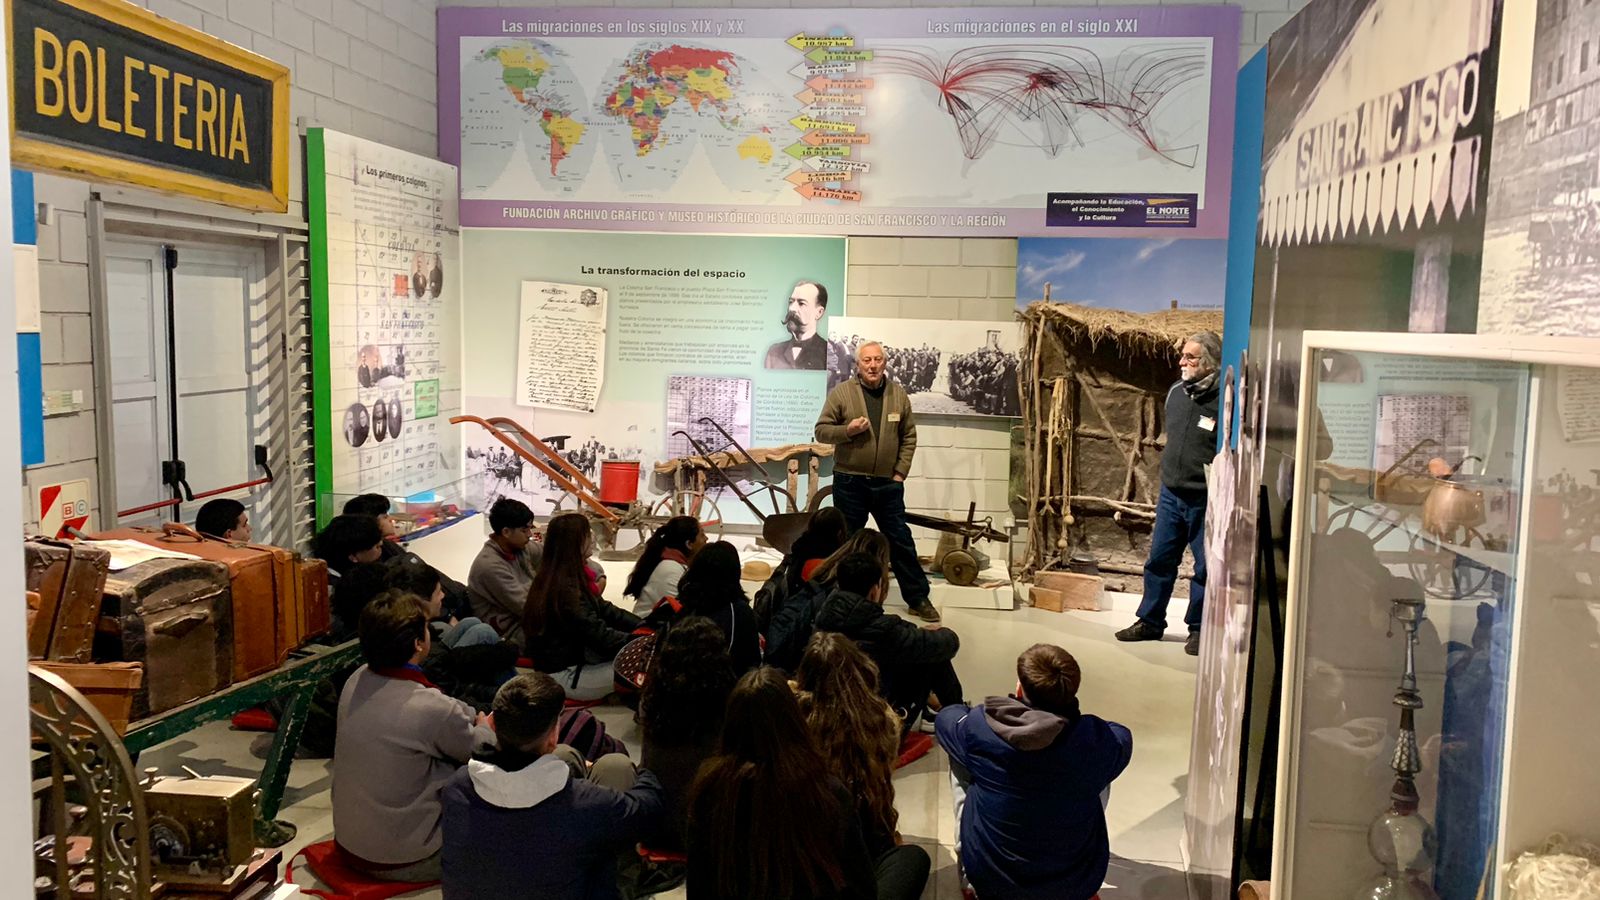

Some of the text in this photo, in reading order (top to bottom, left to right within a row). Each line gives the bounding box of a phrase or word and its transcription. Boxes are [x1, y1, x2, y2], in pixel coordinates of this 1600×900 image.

[502, 19, 744, 35] Las migraciones en los siglos XIX y XX
[927, 19, 1138, 35] Las migraciones en el siglo XXI
[34, 27, 250, 164] BOLETERIA
[818, 159, 867, 168] VARSOVIA
[366, 165, 378, 177] Los
[378, 169, 406, 183] primeros
[1053, 198, 1099, 206] Acompañando
[503, 206, 1006, 226] FUNDACIÓN ARCHIVO GRÁFICO Y MUSEO HISTÓRICO DE LA CIUDAD DE SAN FRANCISCO Y LA REGIÓN
[1159, 207, 1189, 215] NORTE
[581, 266, 746, 278] La transformación del espacio
[64, 503, 84, 515] B C
